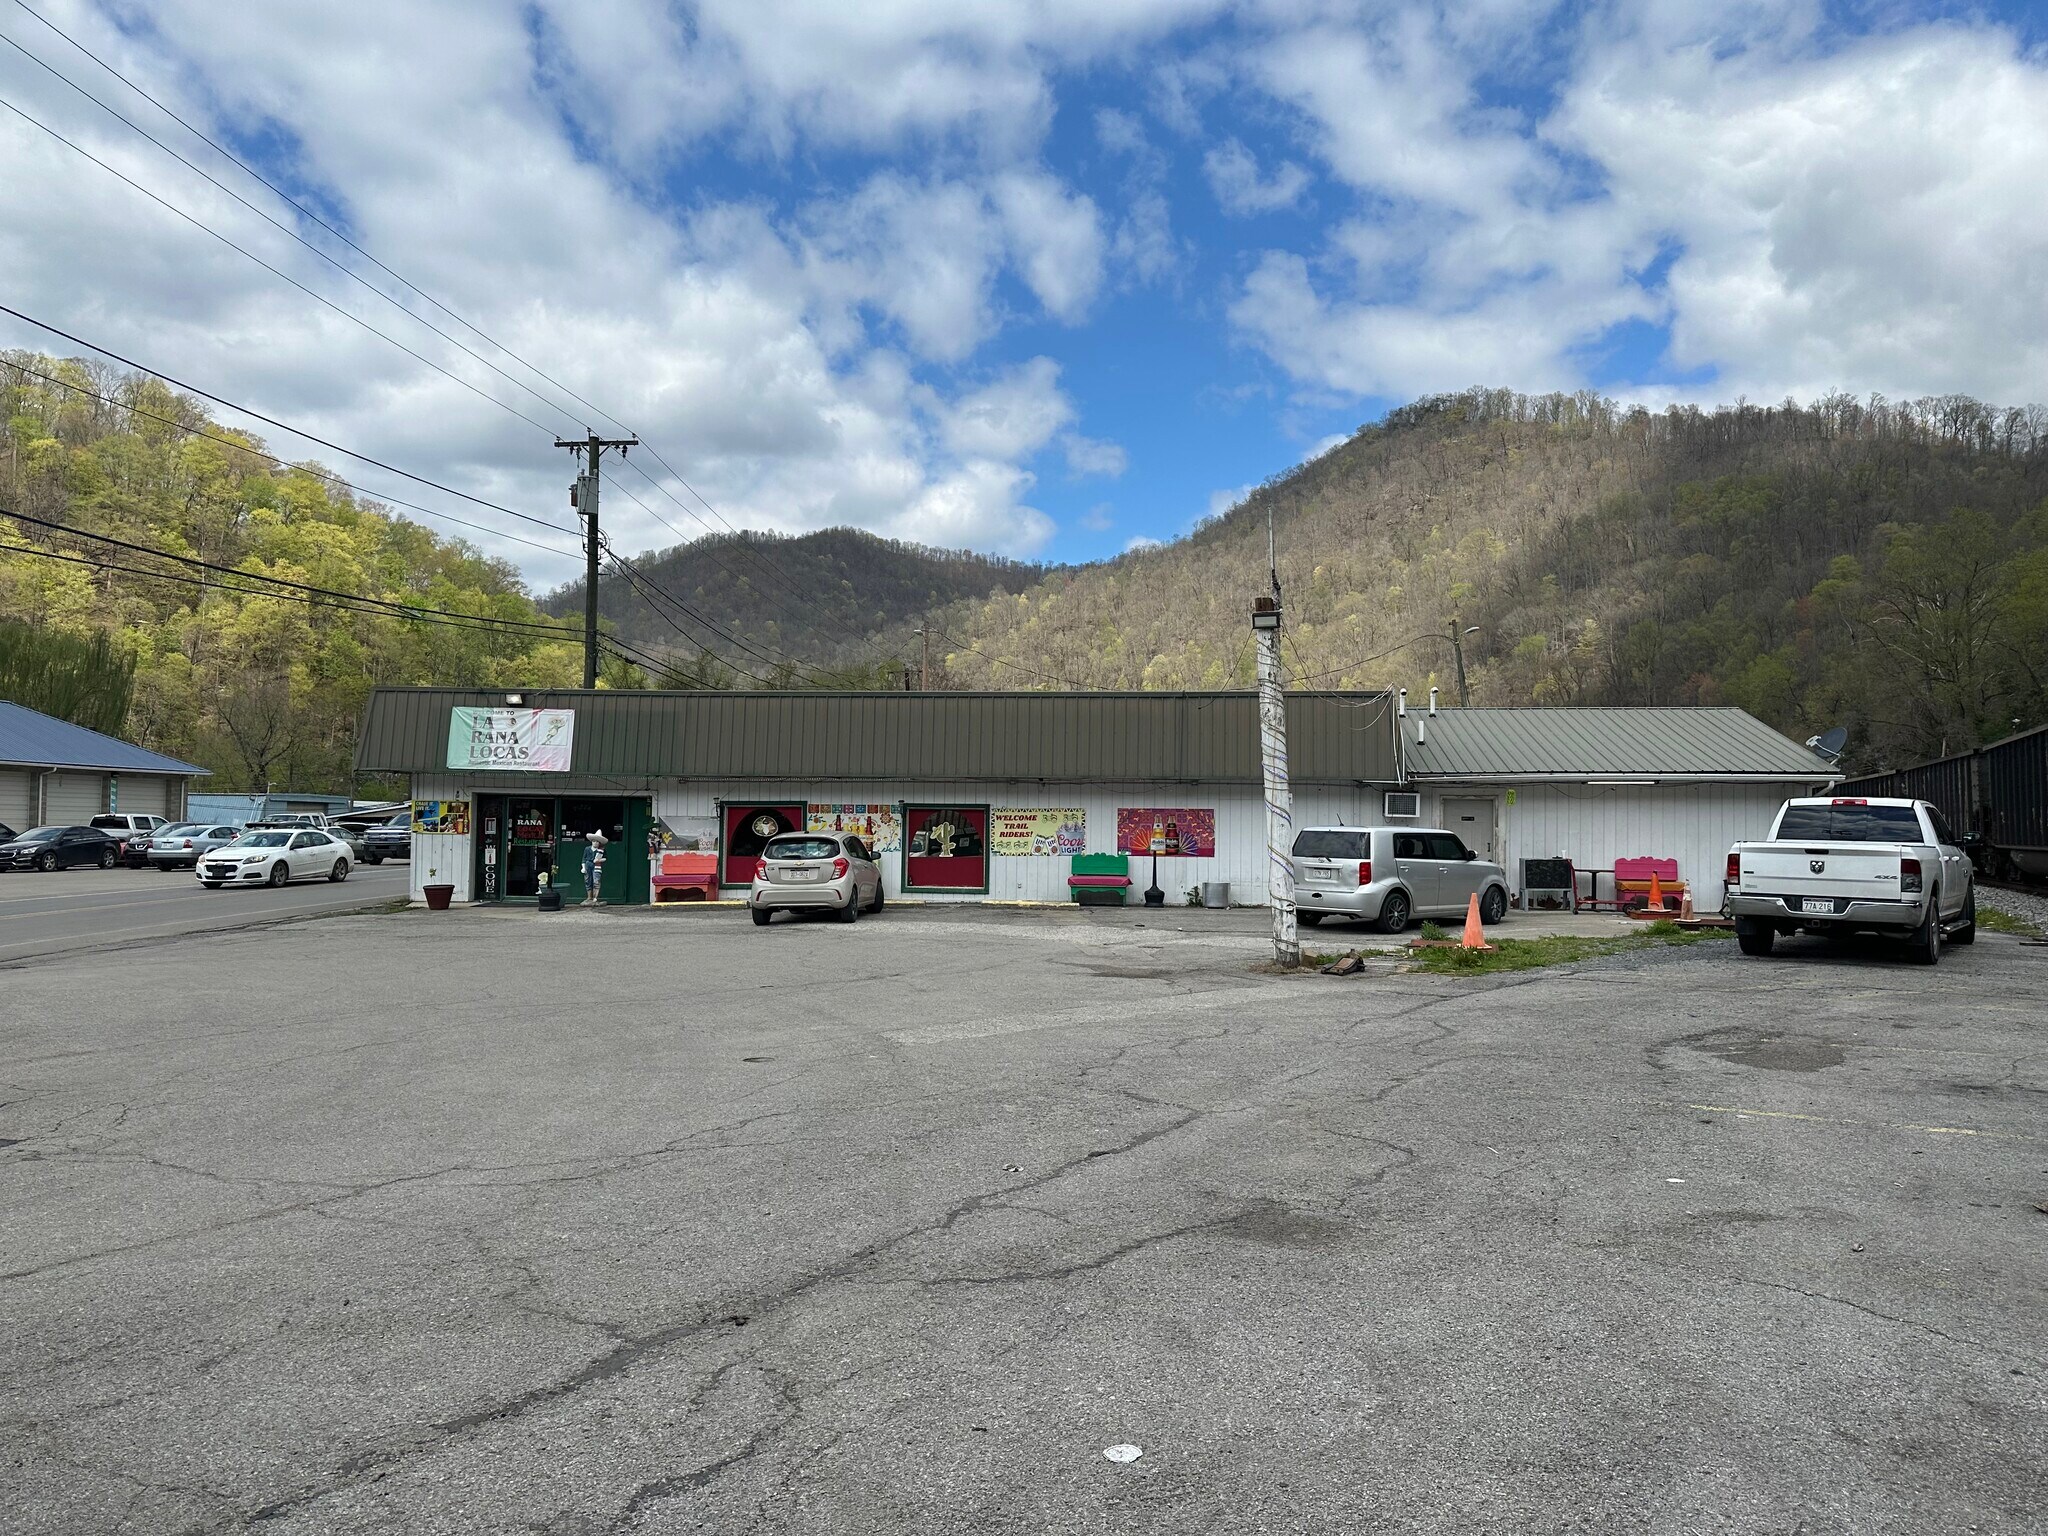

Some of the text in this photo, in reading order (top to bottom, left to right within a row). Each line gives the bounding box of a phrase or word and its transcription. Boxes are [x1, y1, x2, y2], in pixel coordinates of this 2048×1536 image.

[472, 716, 494, 729] LA
[471, 731, 519, 744] RANA
[469, 746, 530, 760] LOCAS
[485, 845, 496, 893] WCOME
